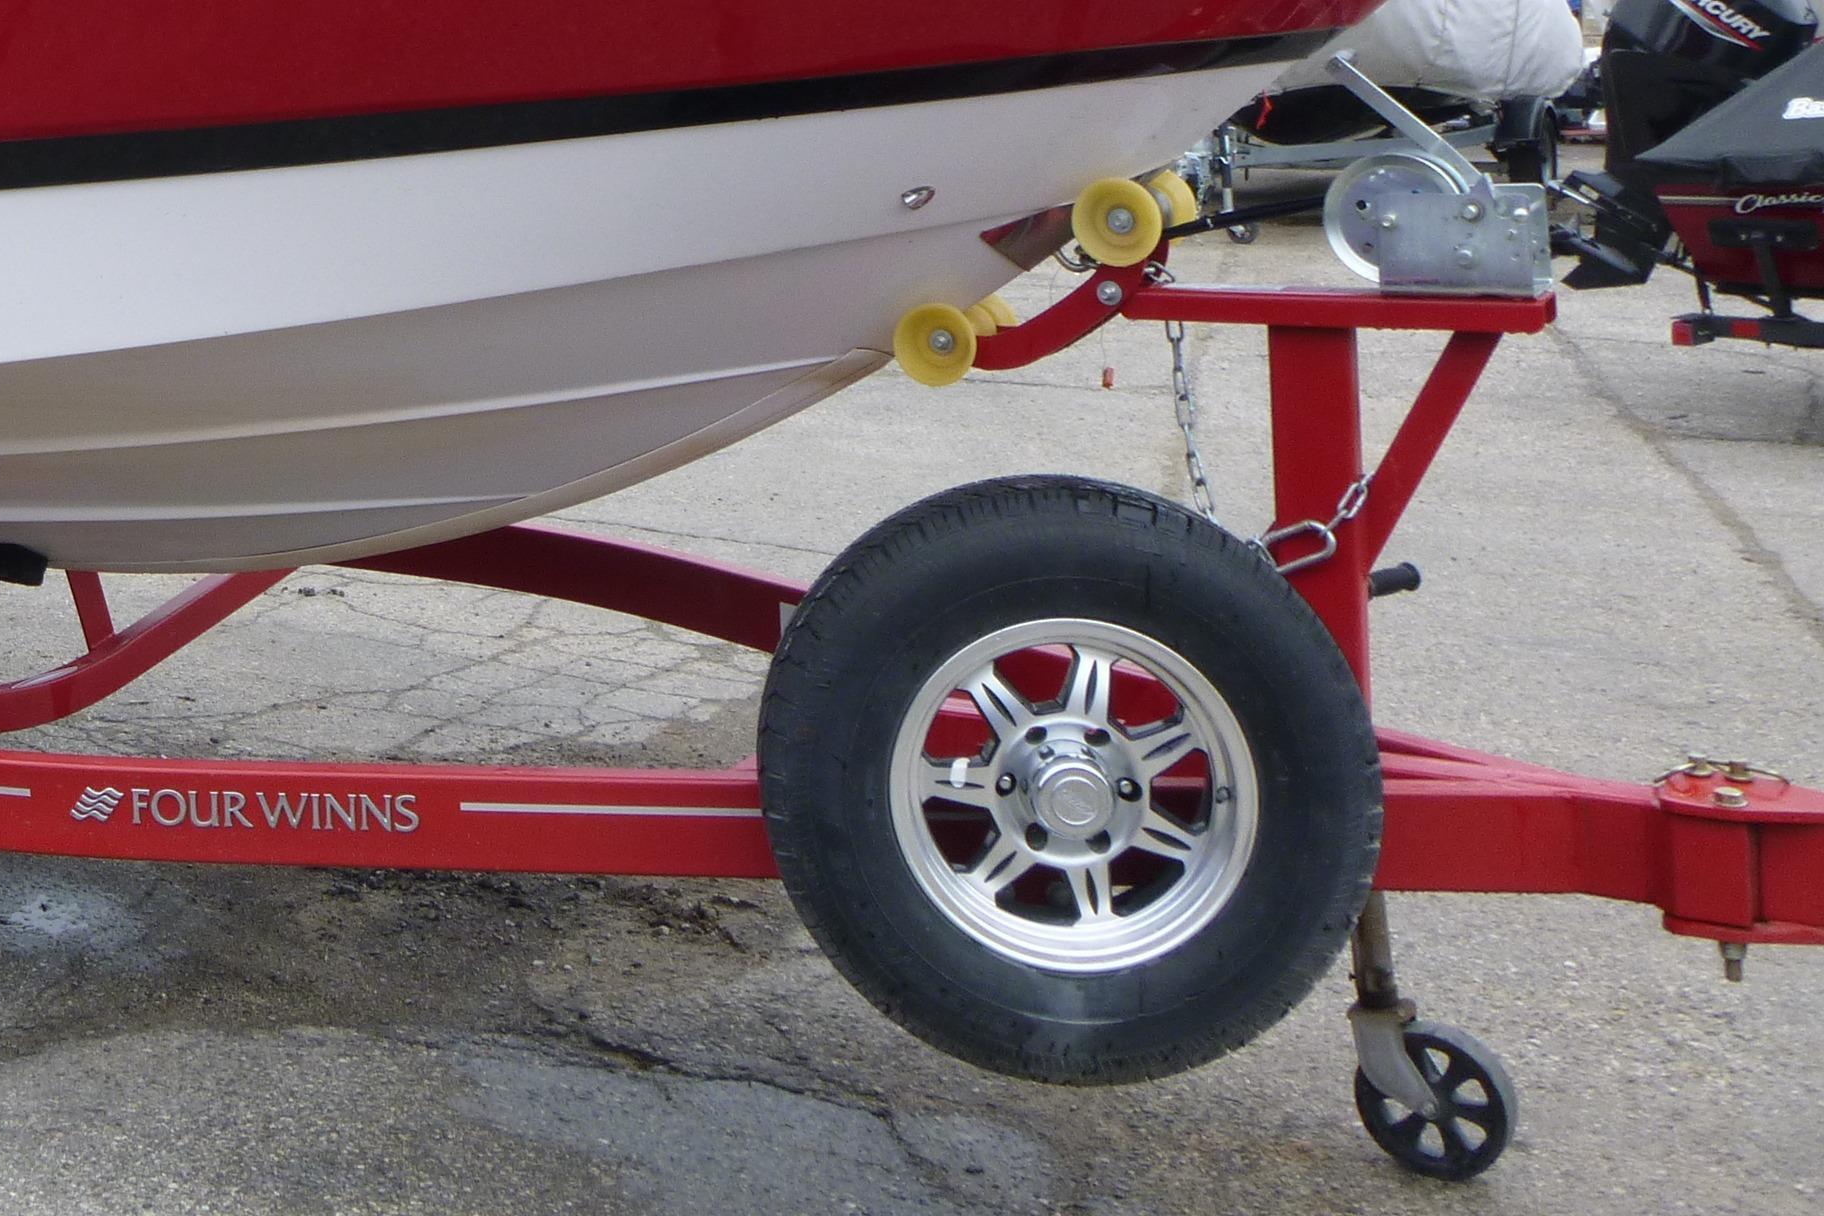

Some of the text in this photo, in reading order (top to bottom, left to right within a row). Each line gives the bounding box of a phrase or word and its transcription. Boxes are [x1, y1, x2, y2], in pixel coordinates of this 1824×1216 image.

[1735, 192, 1824, 214] Classic
[130, 787, 420, 834] FOUR WINNS
